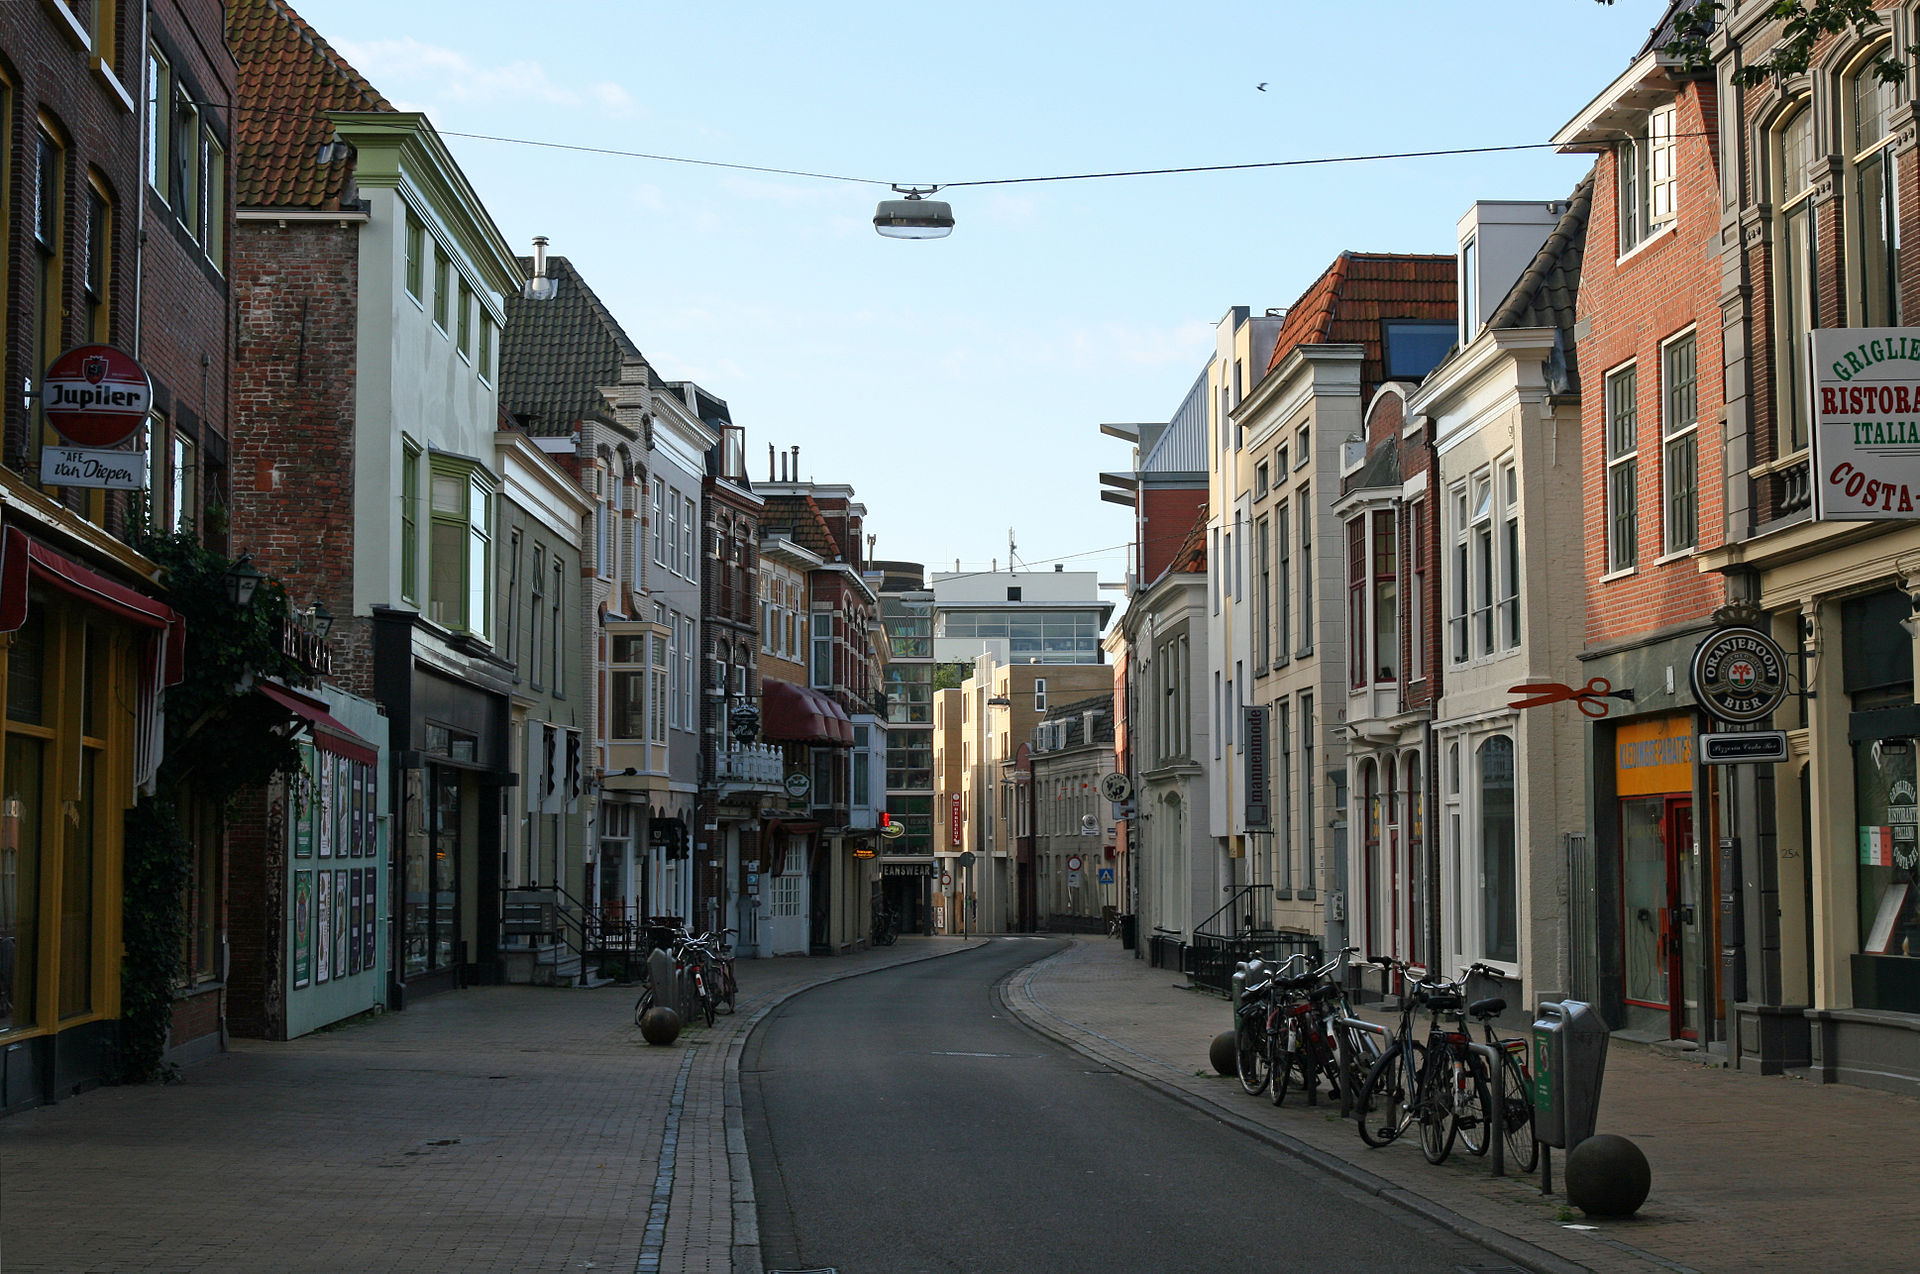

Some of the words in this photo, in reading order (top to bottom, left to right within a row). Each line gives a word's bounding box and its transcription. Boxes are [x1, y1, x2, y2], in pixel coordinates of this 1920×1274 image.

[1832, 337, 1920, 382] GRIGLIE
[51, 385, 140, 409] Jupiler
[1853, 421, 1920, 445] ITALIA
[55, 463, 80, 478] van
[83, 459, 134, 482] Diepen
[1706, 639, 1778, 678] ORANJEBOOM
[1724, 697, 1763, 711] BIER
[1248, 710, 1263, 802] mannenmode
